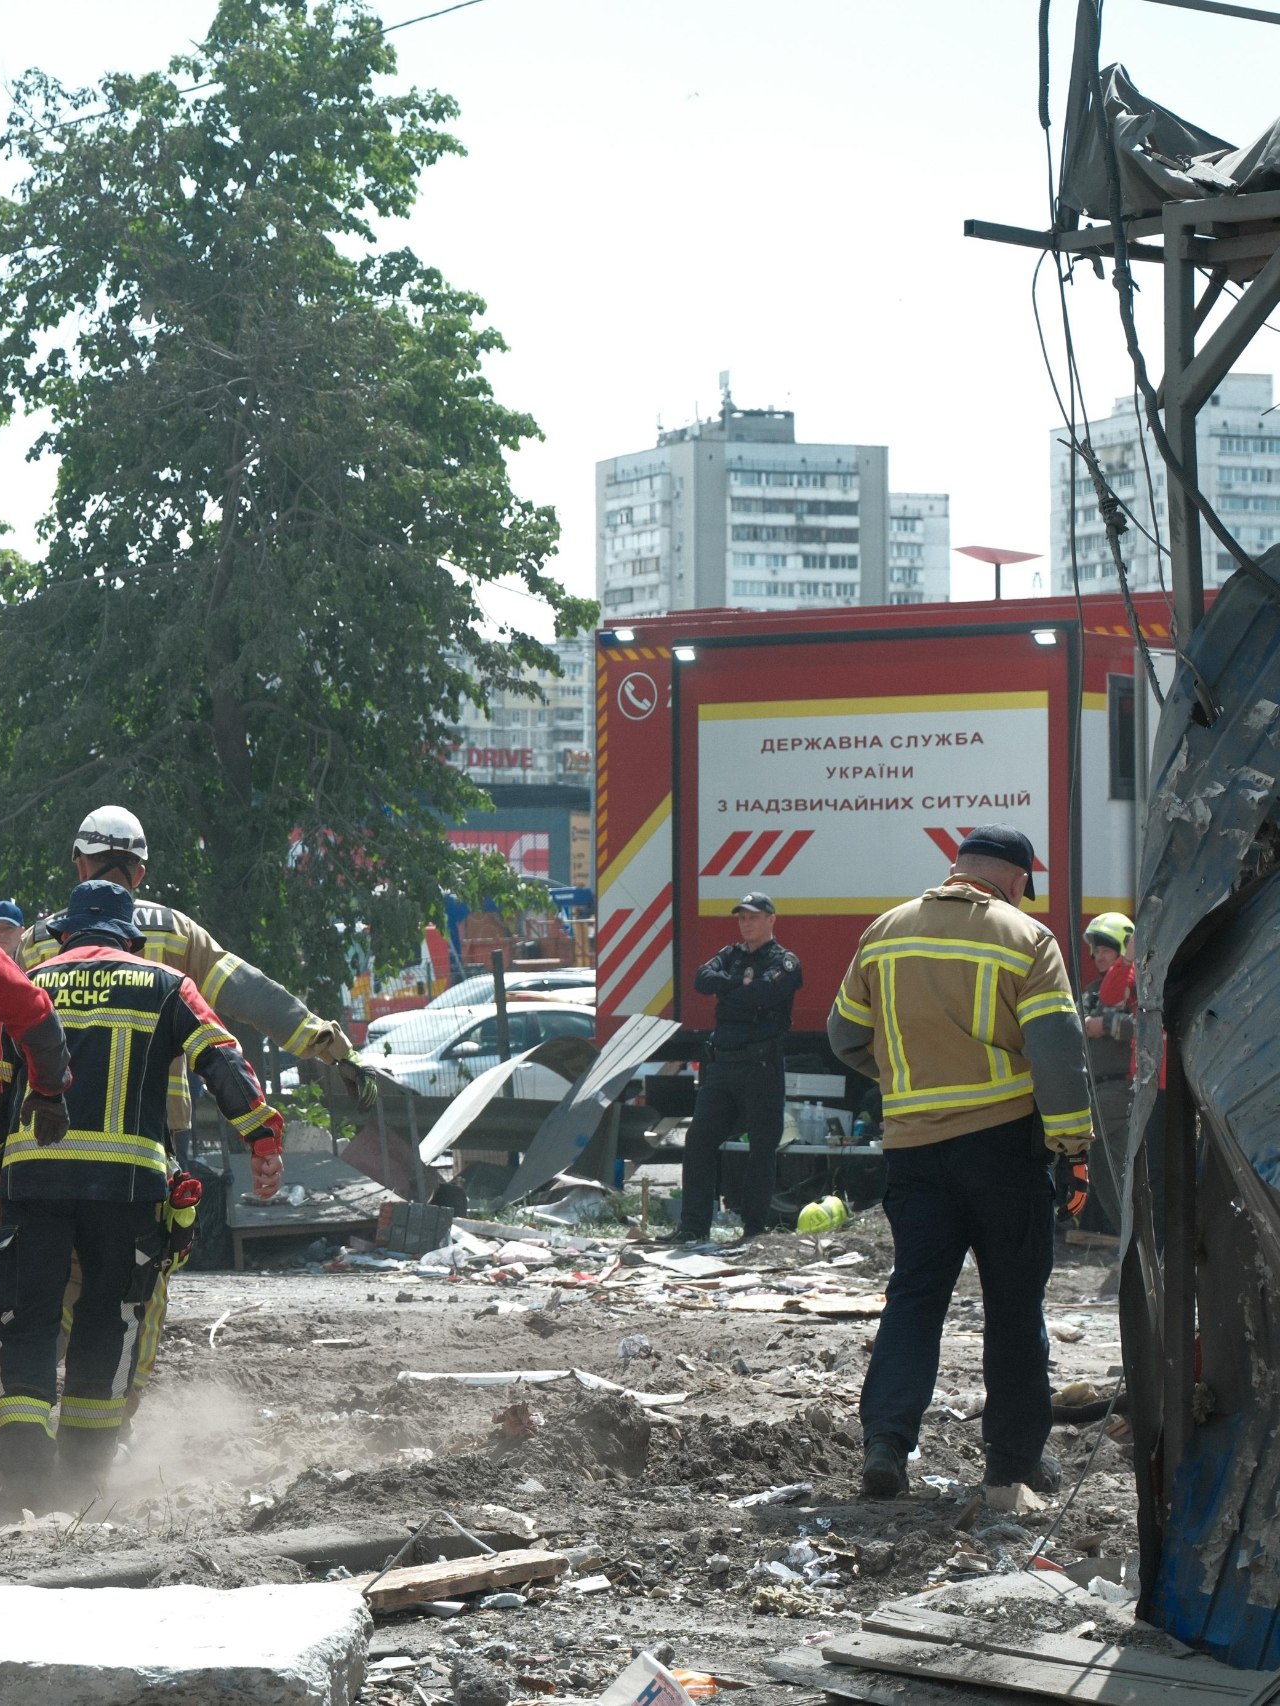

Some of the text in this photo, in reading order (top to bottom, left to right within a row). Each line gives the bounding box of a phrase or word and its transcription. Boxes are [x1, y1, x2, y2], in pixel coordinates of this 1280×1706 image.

[761, 731, 984, 754] ДЕРЖАВНА СЛУЖБА
[467, 747, 533, 769] DRIVE
[825, 764, 915, 779] УКРАЇНИ
[735, 794, 915, 814] НАДЗВИЧАЙНИХ
[921, 790, 1032, 809] СИТУАЦІЙ
[92, 969, 155, 988] СИСТЕМИ
[54, 989, 111, 1007] ДСНС
